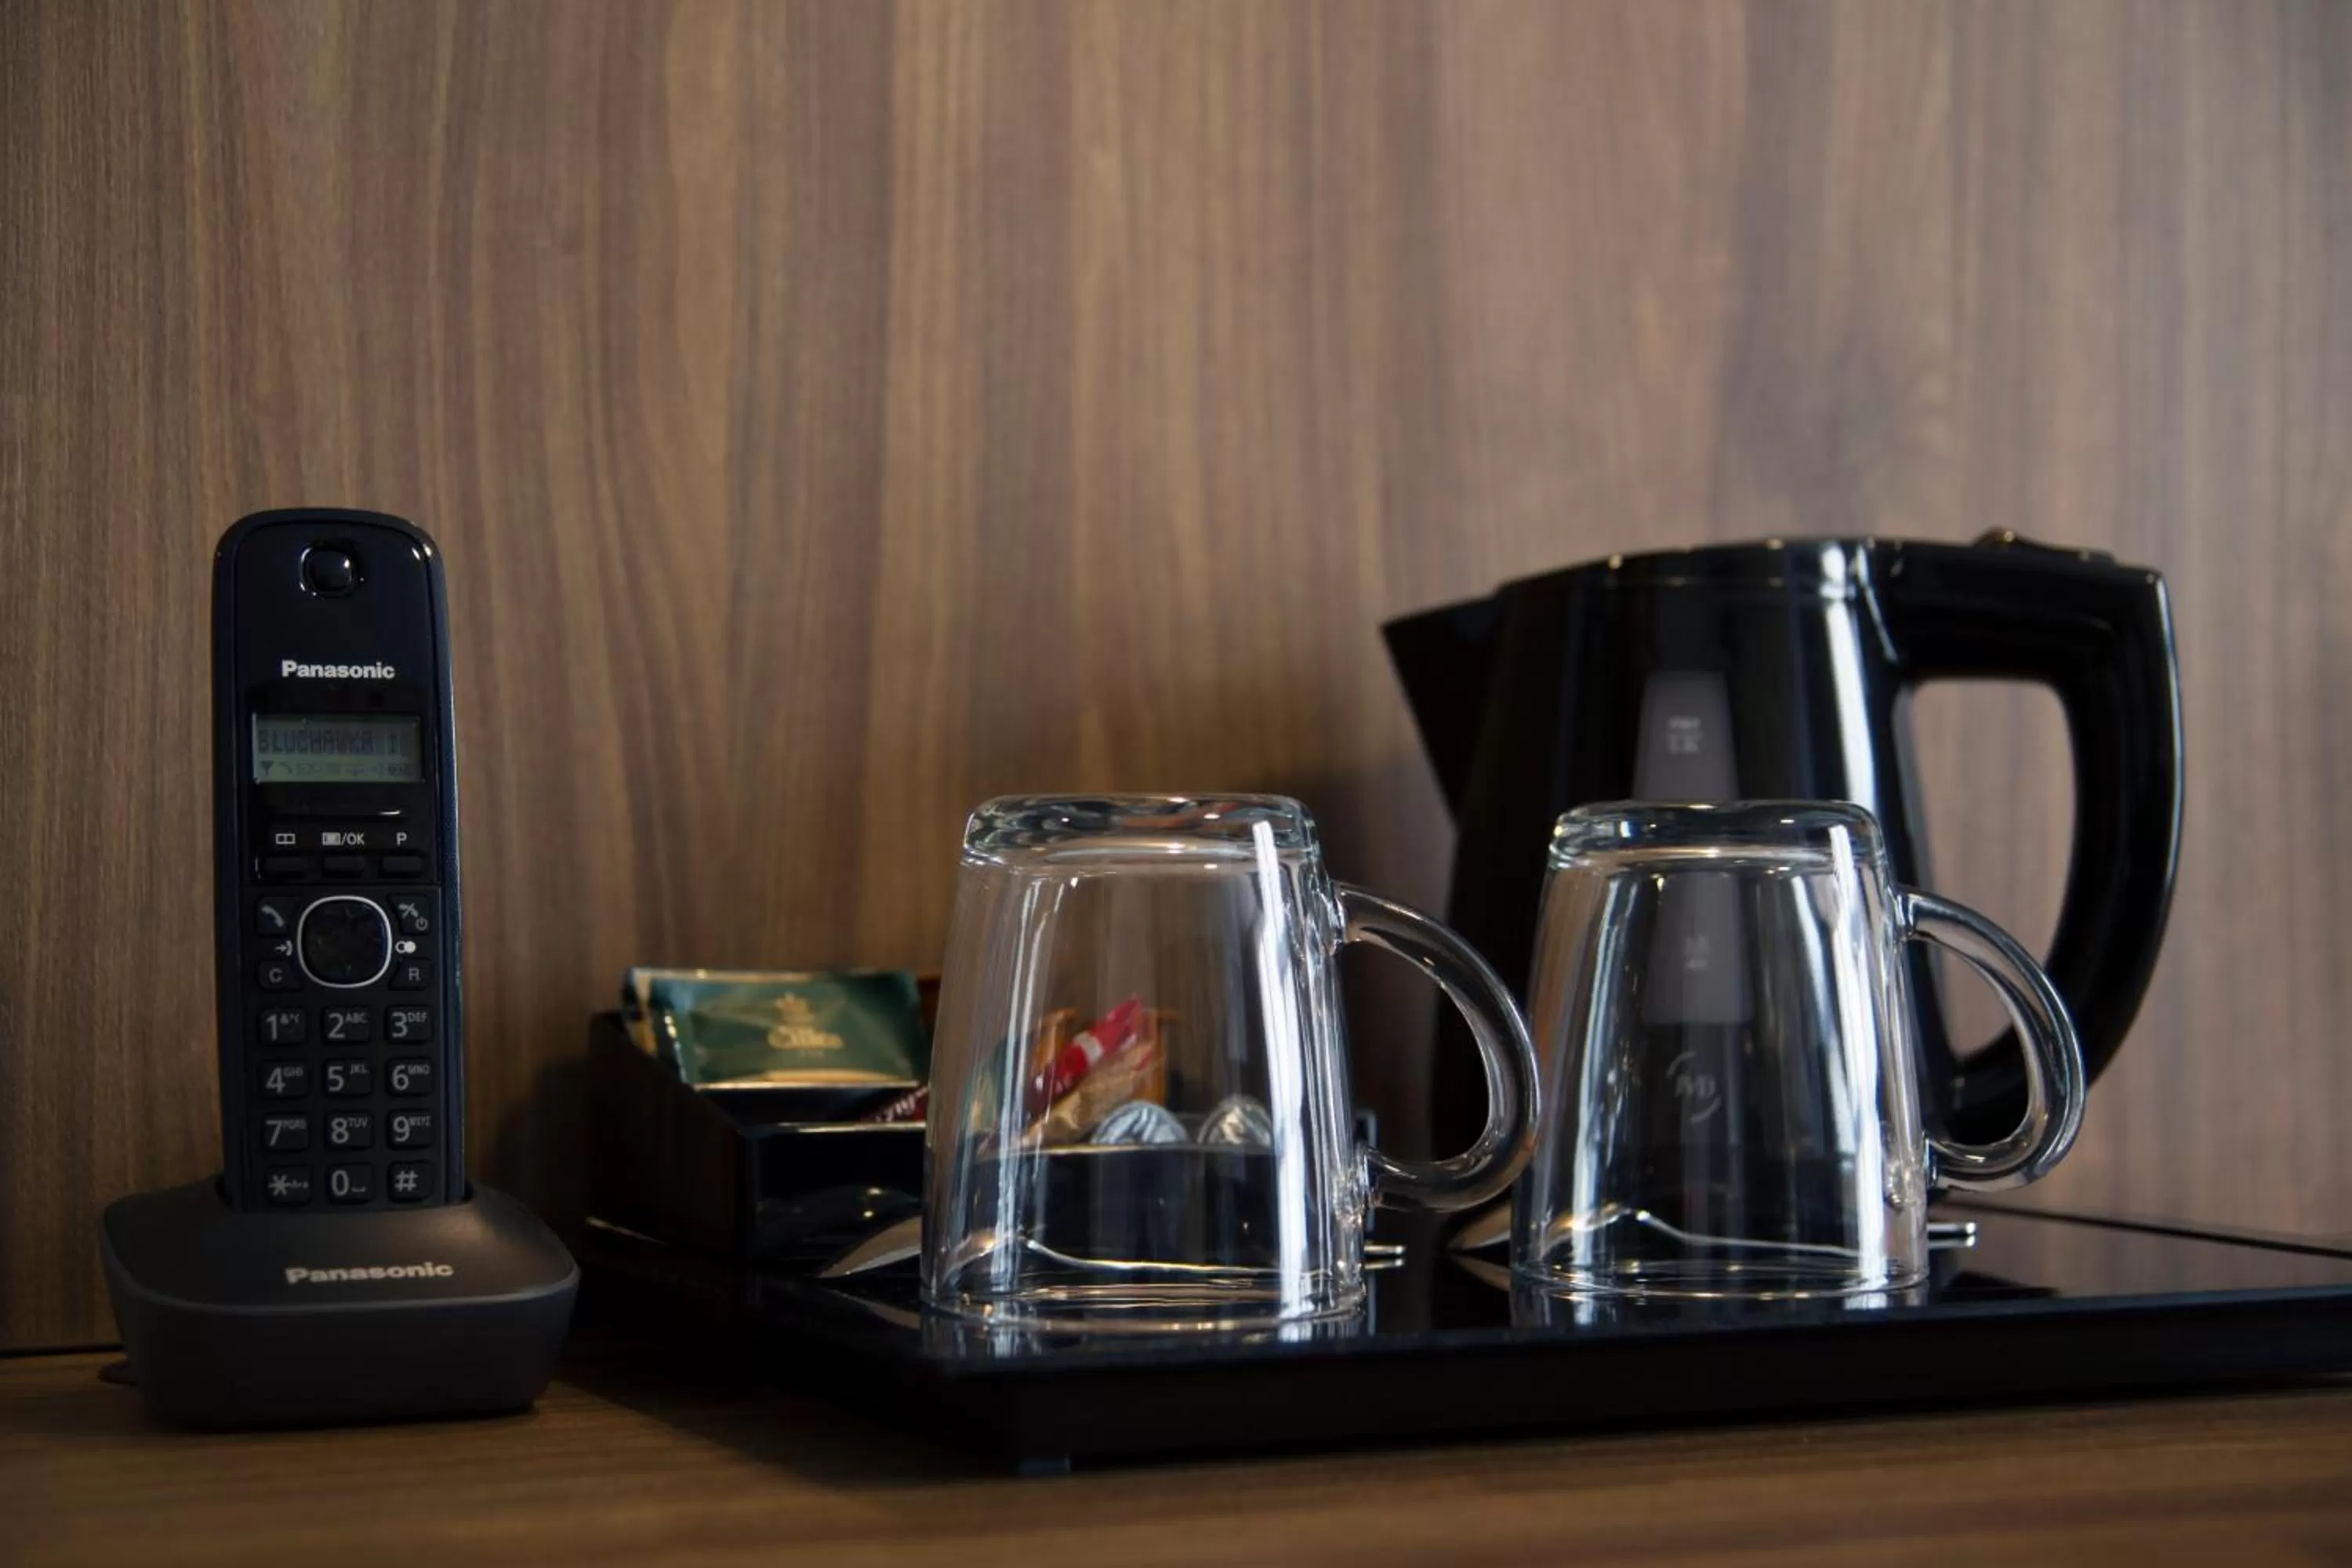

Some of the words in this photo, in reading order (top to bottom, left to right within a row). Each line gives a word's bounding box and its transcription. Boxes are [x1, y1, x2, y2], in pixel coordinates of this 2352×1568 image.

[281, 659, 396, 679] Panasonic
[396, 832, 407, 846] P
[269, 967, 283, 983] C
[408, 967, 421, 982] R
[267, 1014, 278, 1041] 1
[328, 1012, 346, 1040] 2
[392, 1011, 408, 1038] 3
[265, 1066, 286, 1093] 4
[328, 1065, 345, 1092] 5
[393, 1064, 409, 1091] 6
[266, 1120, 283, 1147] 7
[331, 1116, 350, 1144] 8
[394, 1116, 410, 1142] 9
[331, 1169, 350, 1196] 0
[285, 1261, 454, 1286] Panasonic
